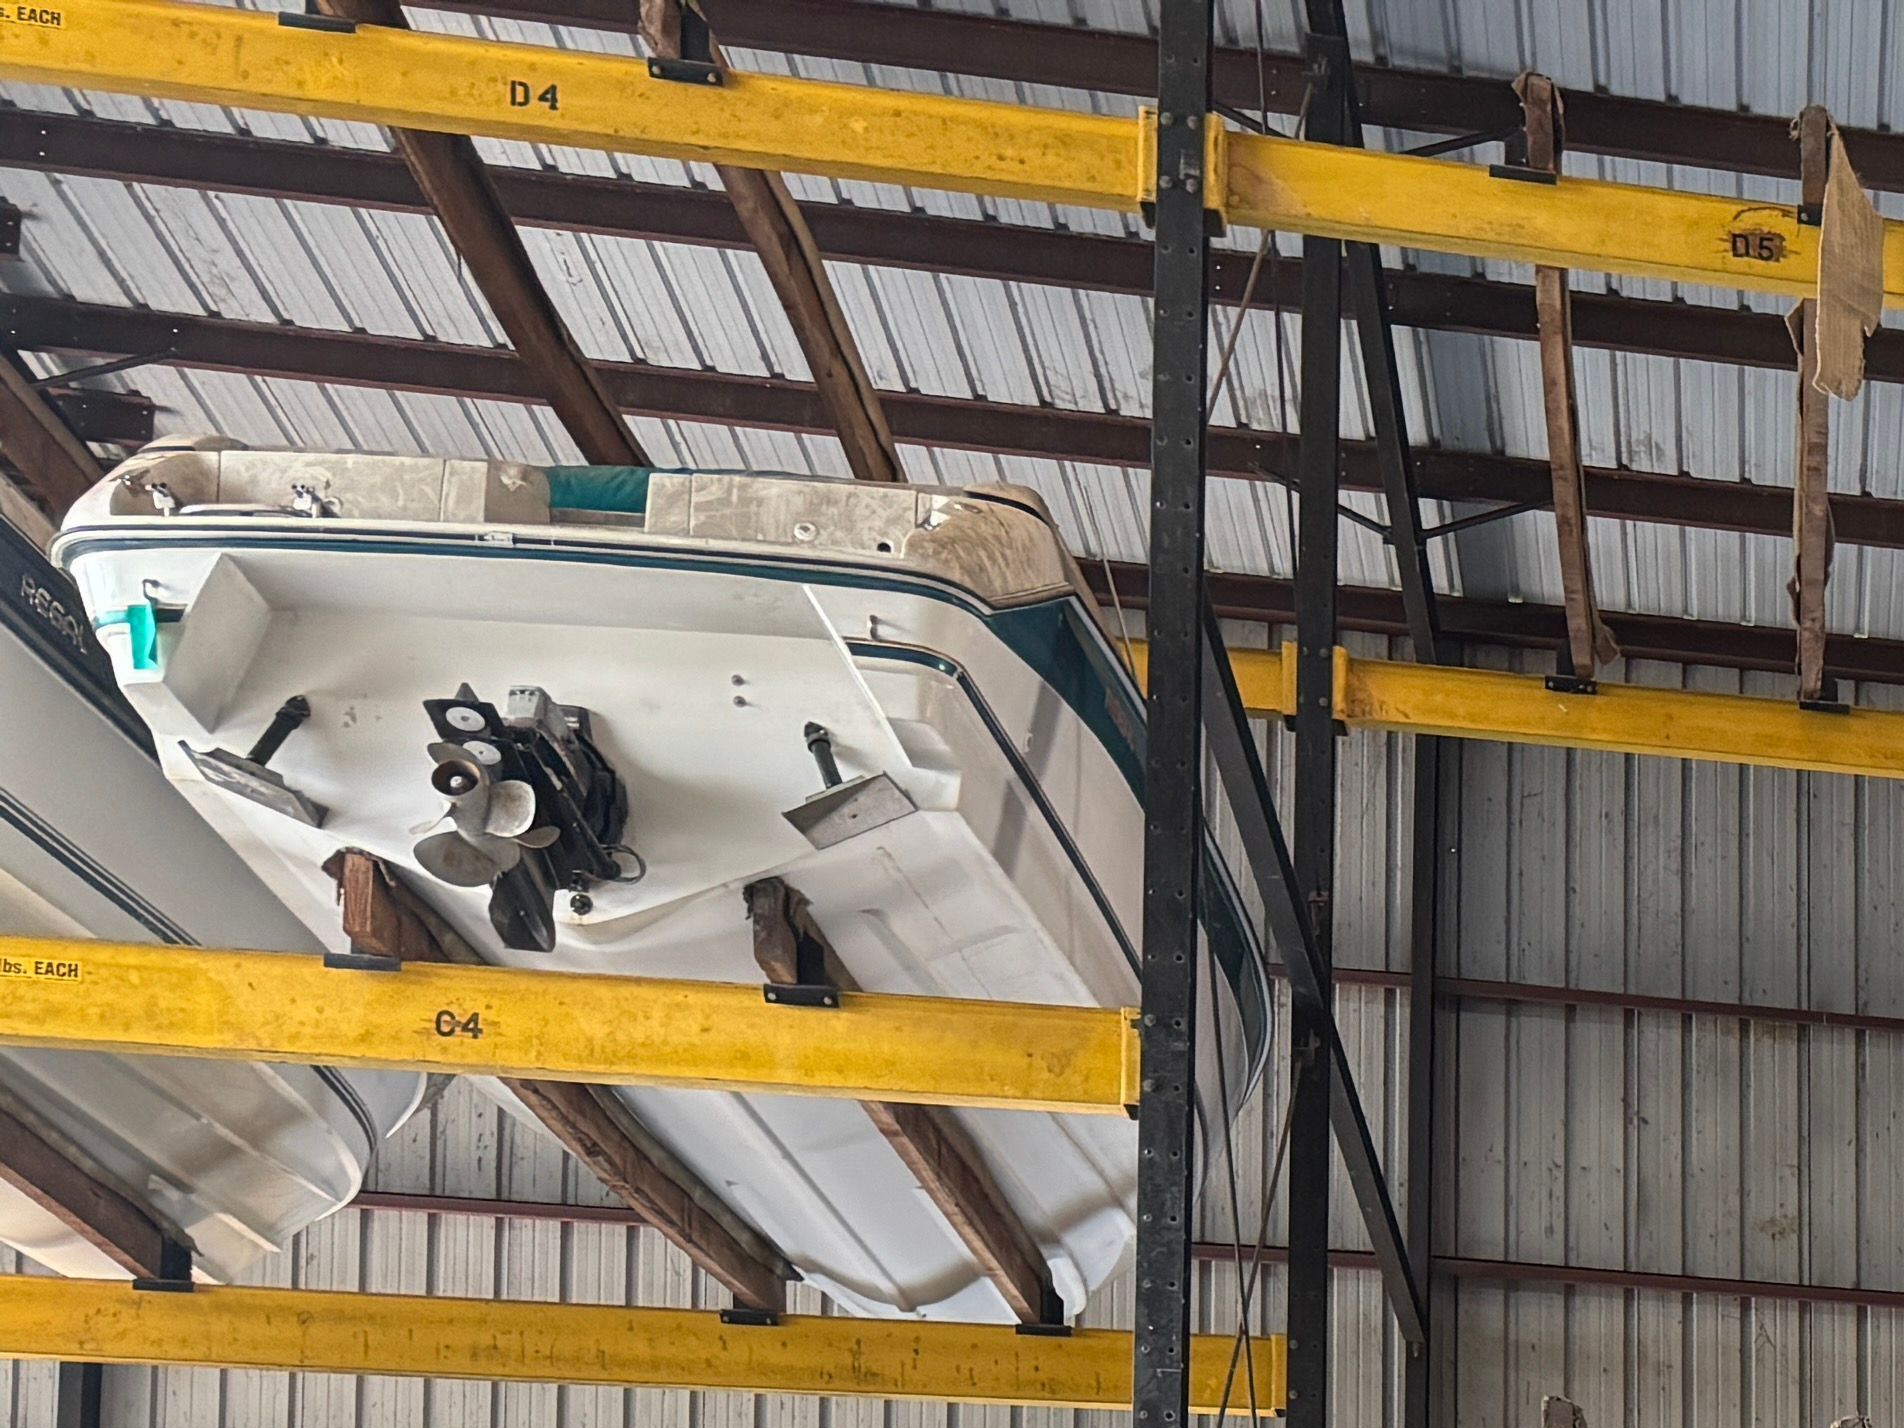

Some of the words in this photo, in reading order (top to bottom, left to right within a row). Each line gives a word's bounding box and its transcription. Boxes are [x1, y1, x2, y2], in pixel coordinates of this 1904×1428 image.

[17, 6, 61, 26] EACH
[510, 79, 559, 111] D4
[1732, 232, 1774, 261] D5
[34, 960, 79, 979] EACH
[435, 1010, 484, 1039] C4
